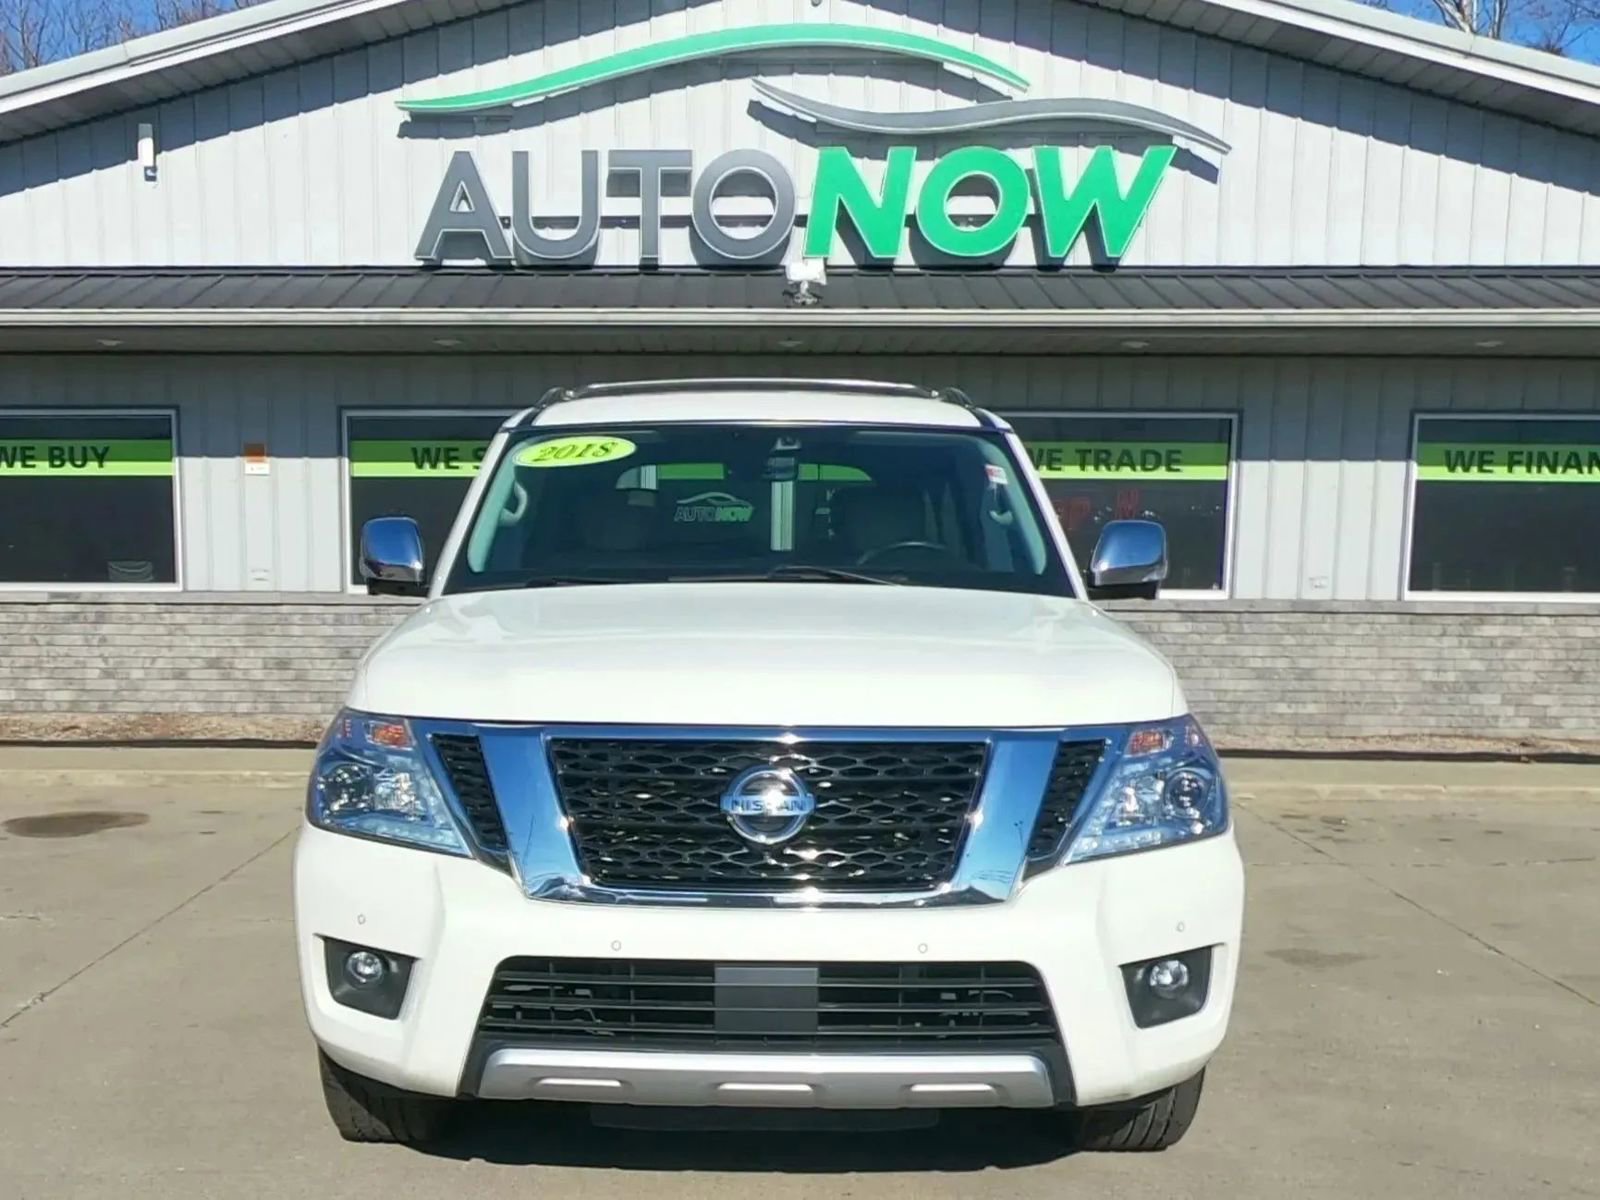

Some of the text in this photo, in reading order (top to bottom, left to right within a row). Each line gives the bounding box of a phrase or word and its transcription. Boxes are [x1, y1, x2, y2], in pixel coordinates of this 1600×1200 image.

[48, 446, 110, 468] BUY
[411, 447, 460, 469] WE
[531, 441, 617, 462] 2018
[1075, 449, 1183, 472] TRADE
[1444, 450, 1495, 473] WE
[731, 800, 804, 811] NISAN
